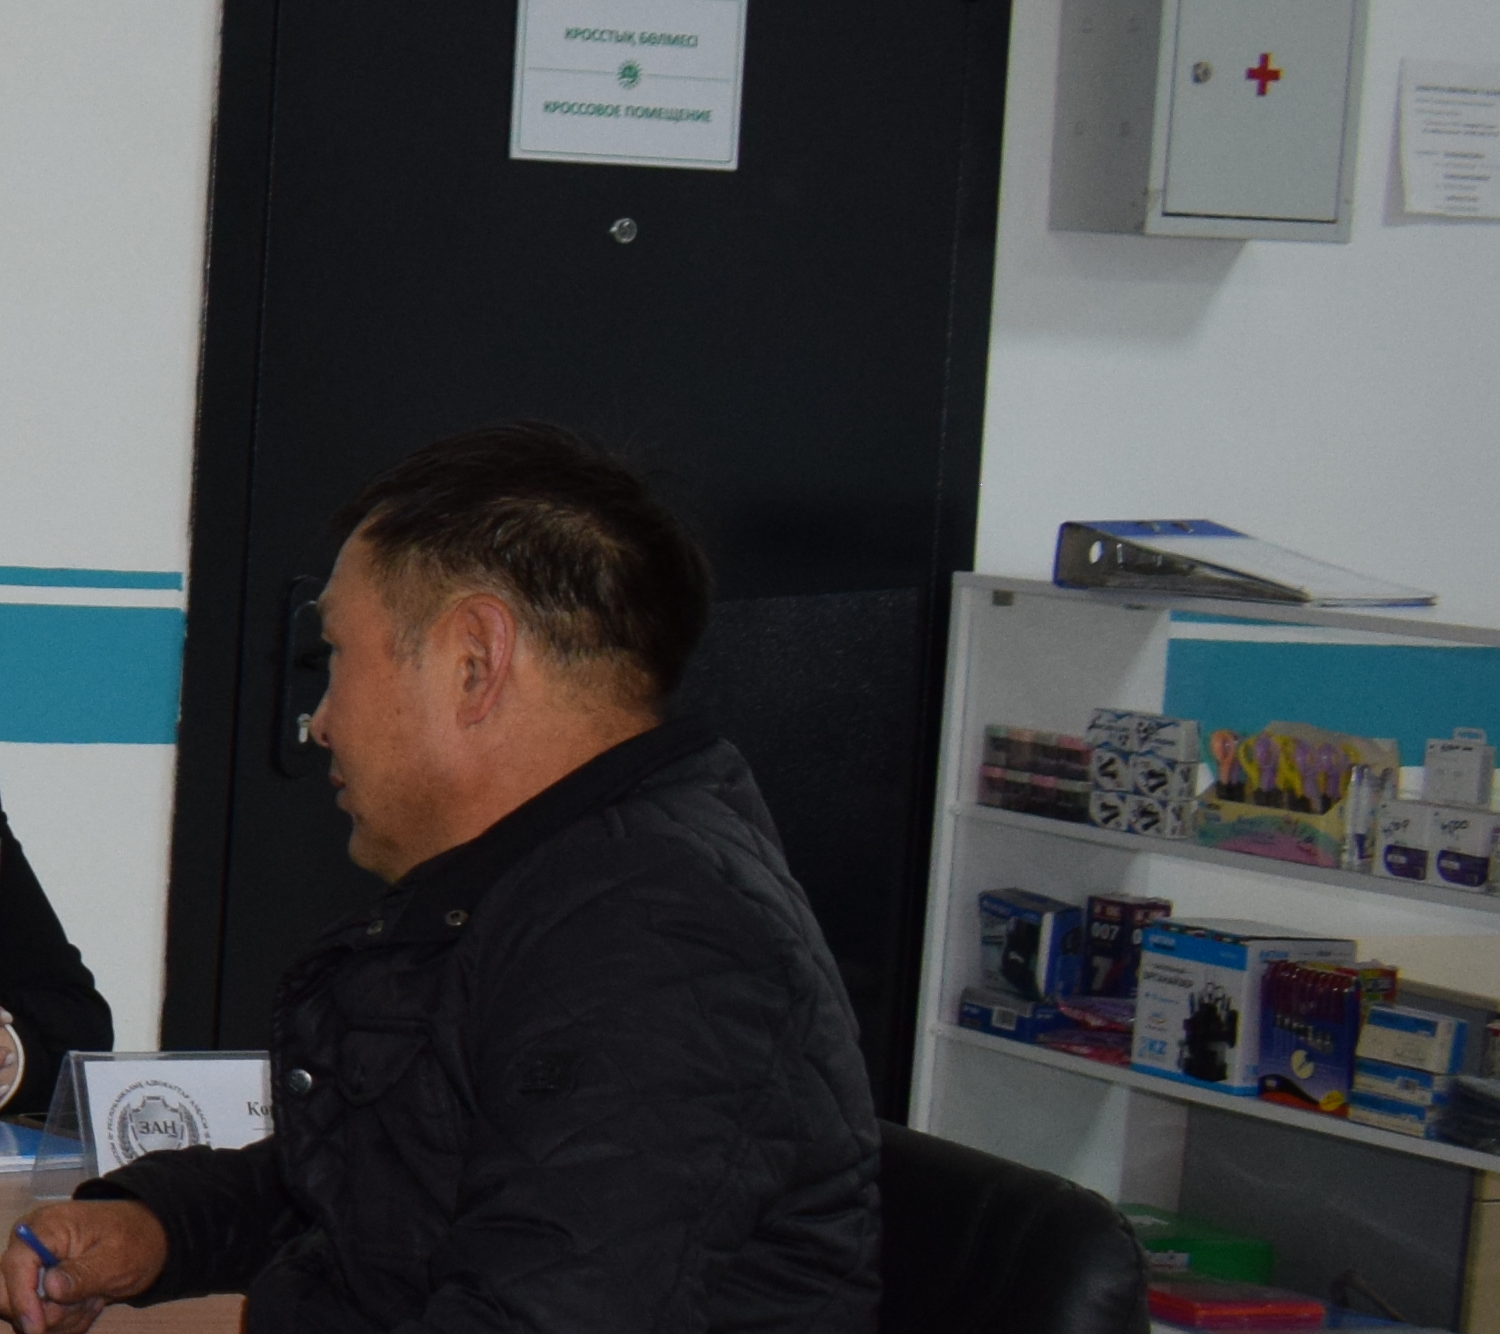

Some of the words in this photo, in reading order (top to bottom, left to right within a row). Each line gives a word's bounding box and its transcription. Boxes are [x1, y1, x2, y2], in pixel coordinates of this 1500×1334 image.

[564, 27, 636, 47] КРОССТЫҚ
[543, 100, 622, 119] КРОССОВОЕ
[624, 104, 713, 124] ПОМЕЩЕНИЕ
[138, 1120, 179, 1138] ЗАҢ
